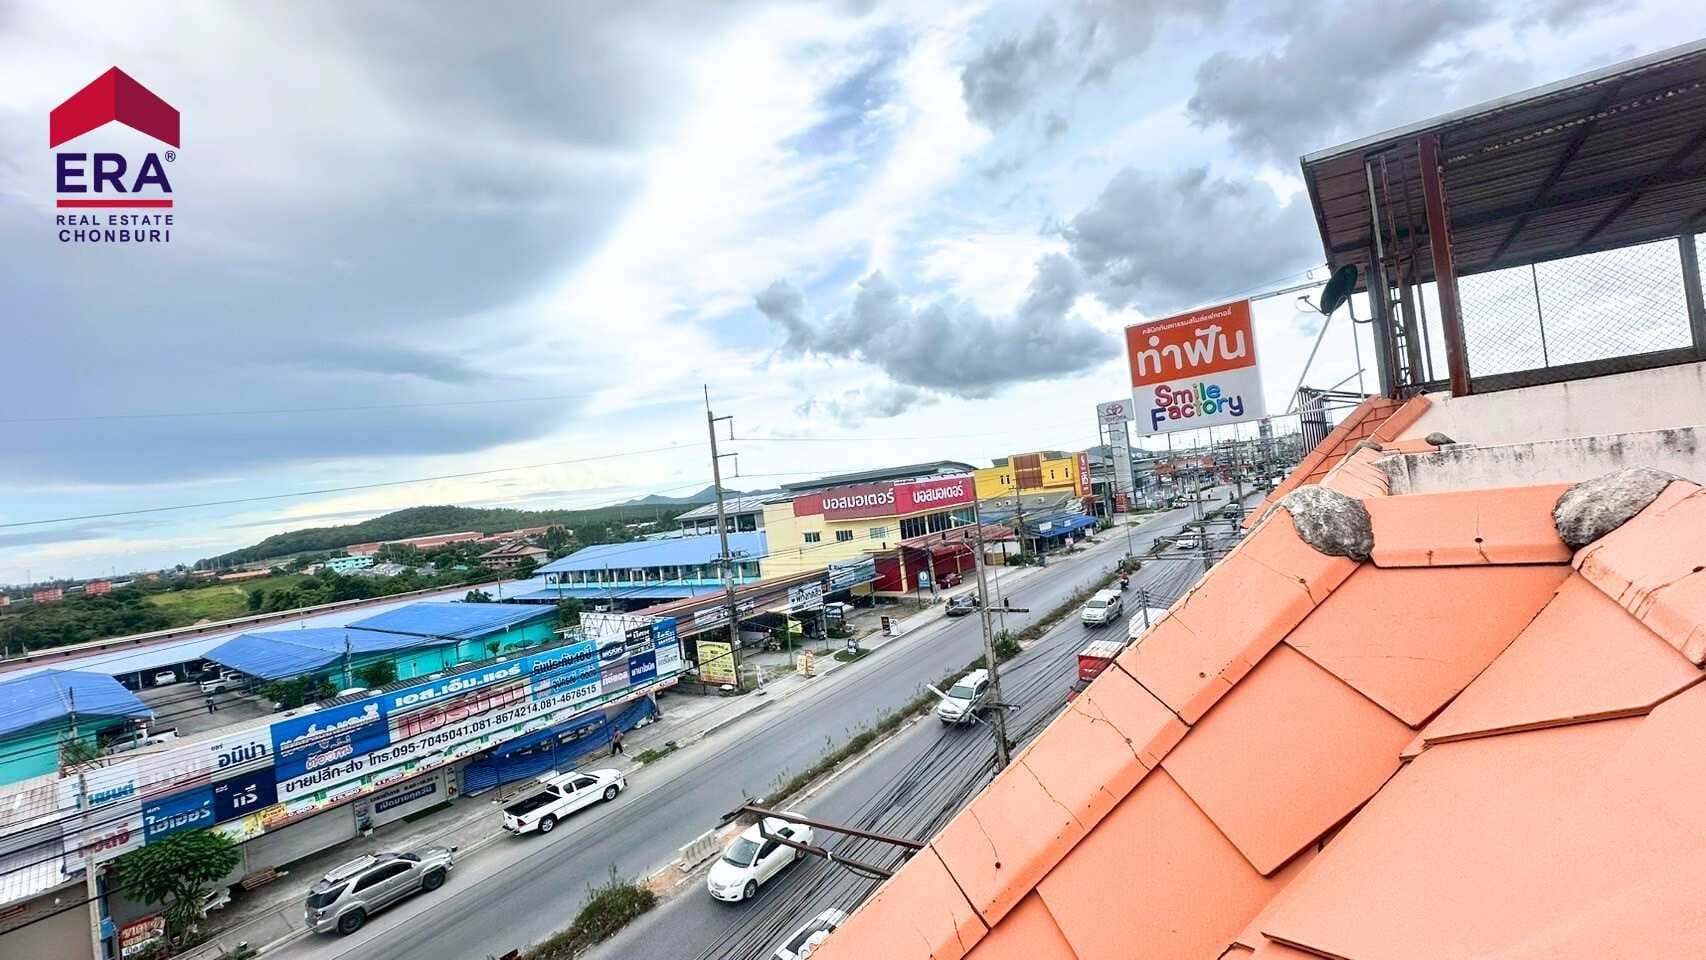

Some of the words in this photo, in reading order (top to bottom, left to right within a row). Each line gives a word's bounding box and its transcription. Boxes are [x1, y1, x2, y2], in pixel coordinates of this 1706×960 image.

[1136, 324, 1247, 378] ทำฟัน
[1154, 382, 1222, 408] Smile
[1150, 394, 1245, 432] Factory
[822, 488, 896, 511] บอสมอเตอร์
[912, 480, 964, 504] บอสมอเตอร์
[395, 662, 521, 707] เอส.เอ็ม.แอร์
[217, 741, 267, 769] อมีน่า
[285, 759, 363, 793] ขายปลีก-ส่ง
